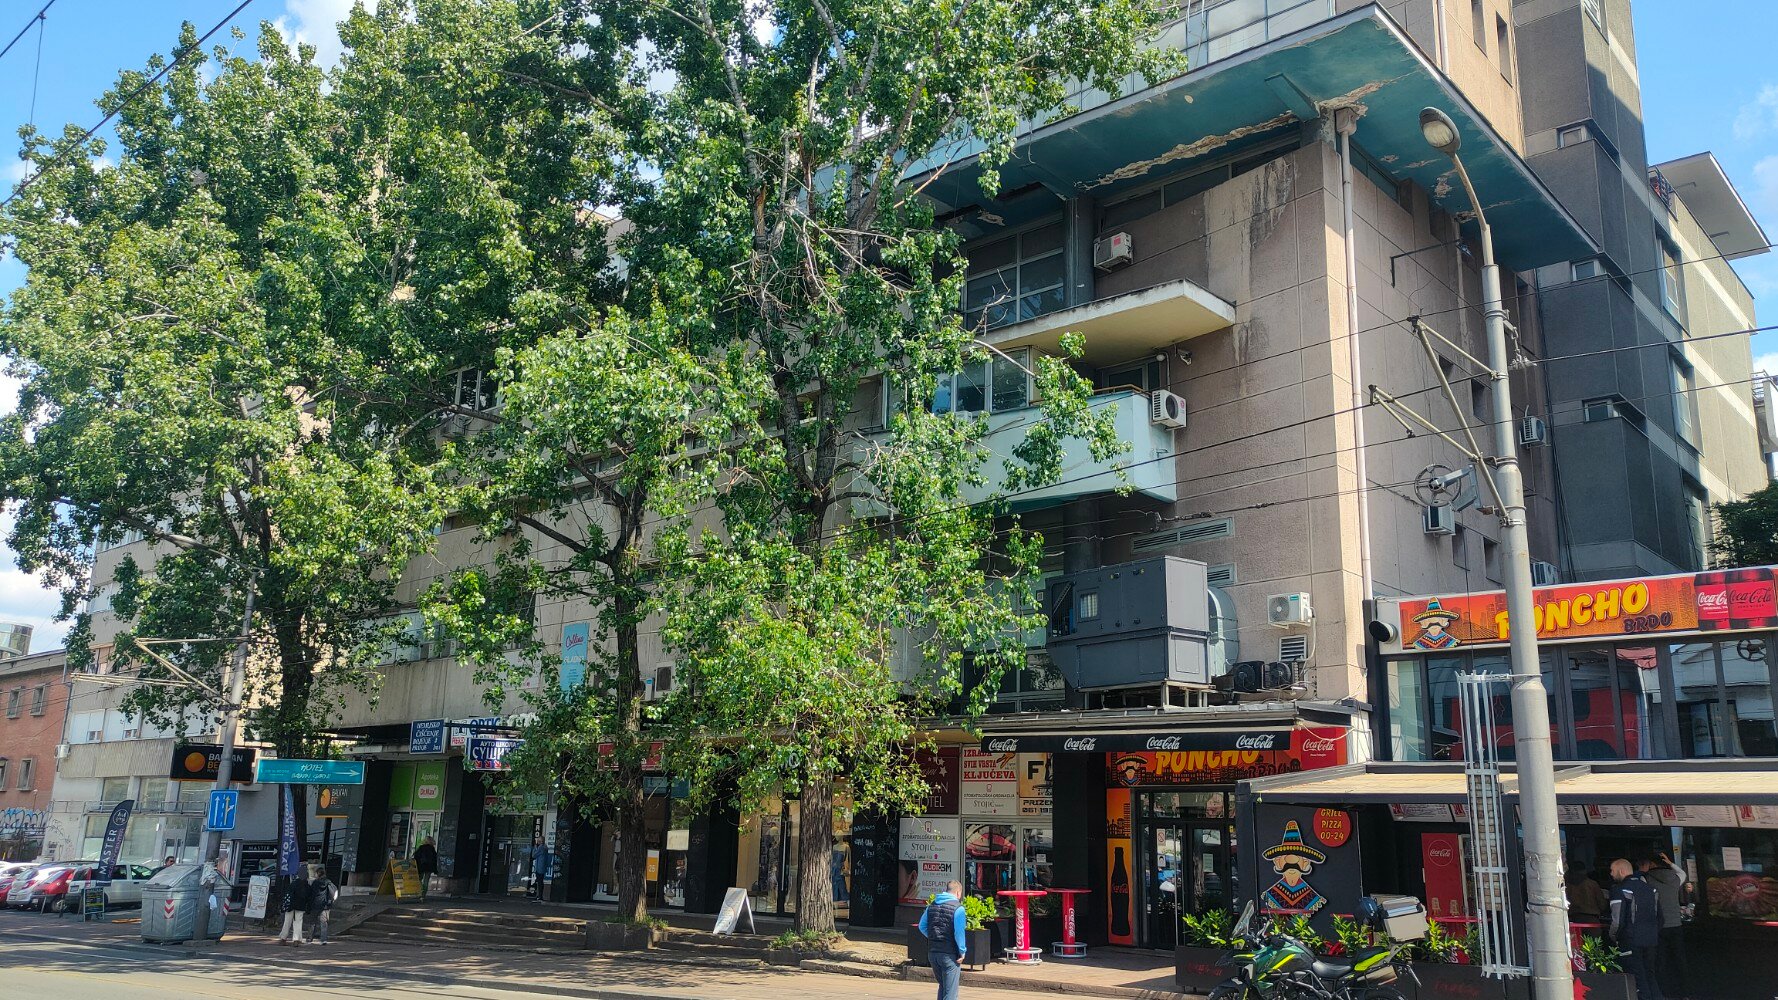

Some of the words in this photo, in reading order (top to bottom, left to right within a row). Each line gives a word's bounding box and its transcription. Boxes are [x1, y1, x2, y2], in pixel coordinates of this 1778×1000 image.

[1623, 611, 1673, 633] BRDO
[300, 763, 324, 771] HOTEL
[964, 769, 1015, 779] KLJUČEVA
[1321, 820, 1343, 829] PIZZA
[1321, 831, 1344, 841] 00-24
[100, 829, 118, 875] MASTER
